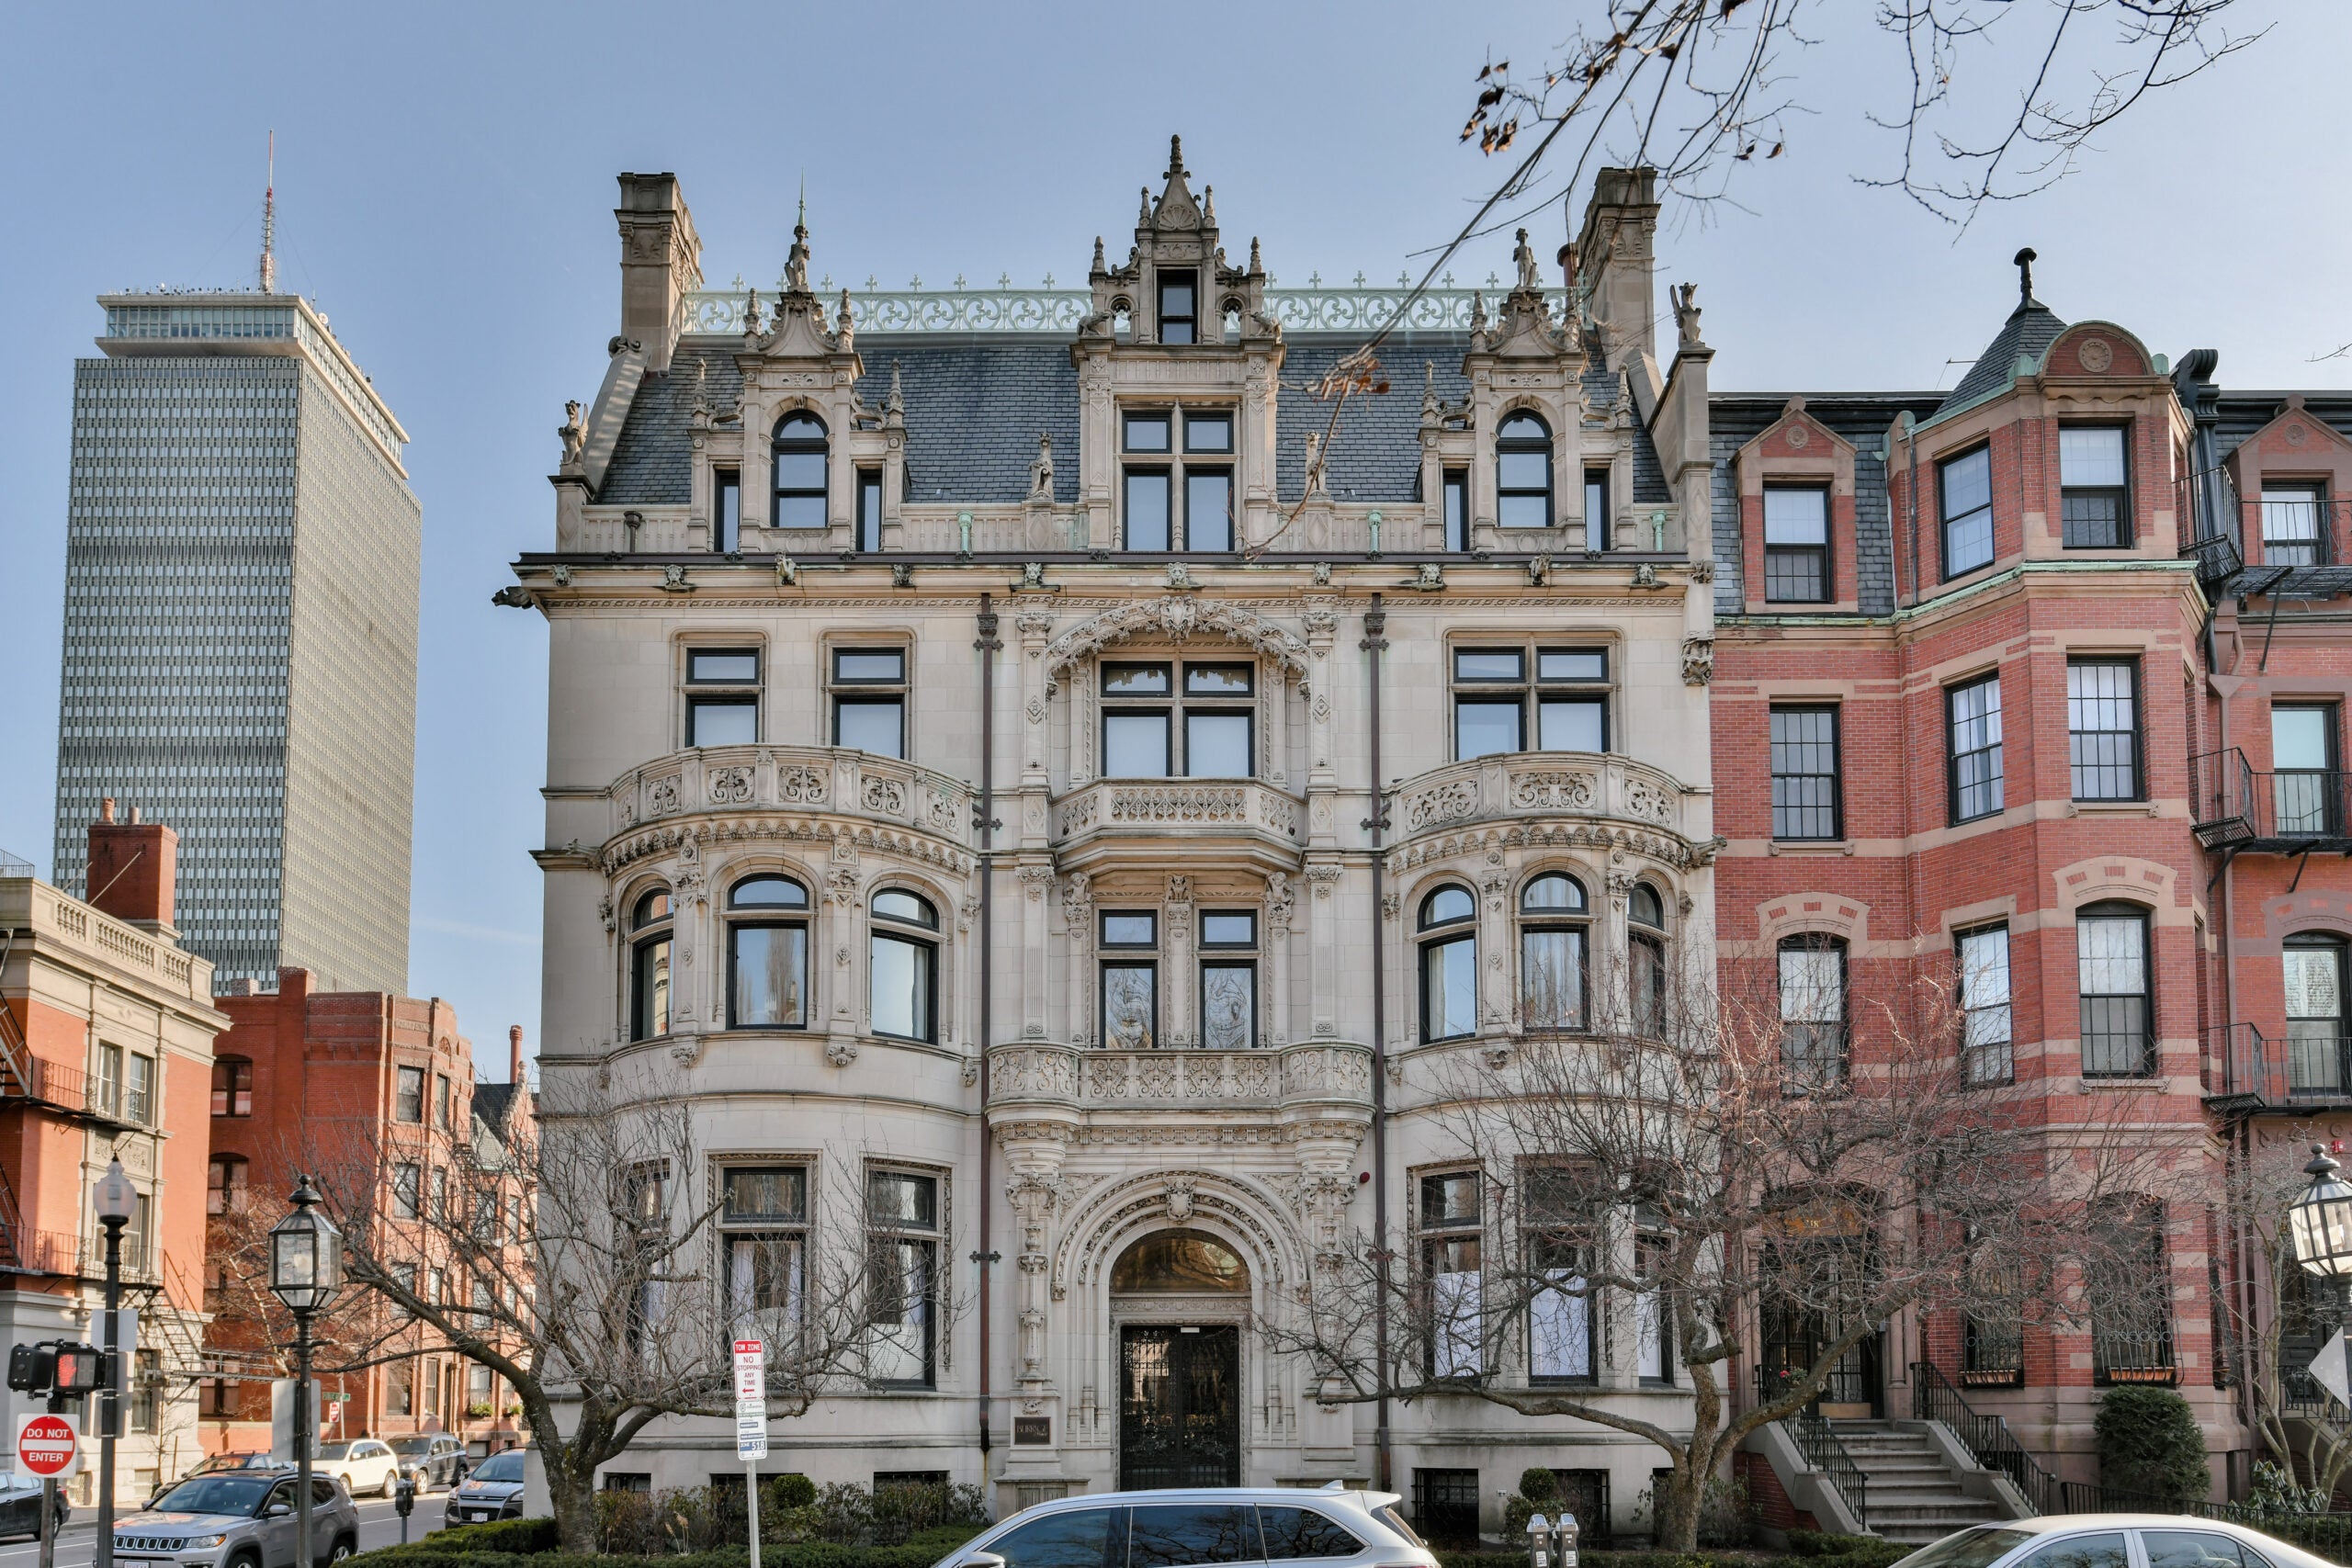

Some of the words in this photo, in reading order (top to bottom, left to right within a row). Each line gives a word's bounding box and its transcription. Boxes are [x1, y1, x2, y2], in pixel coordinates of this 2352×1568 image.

[317, 337, 387, 431] PRUDENTIAL
[747, 1343, 761, 1351] ZONE
[743, 1356, 754, 1364] NO
[27, 1427, 43, 1438] DO
[47, 1428, 69, 1438] NOT
[752, 1440, 765, 1450] 518
[28, 1451, 64, 1462] ENTER
